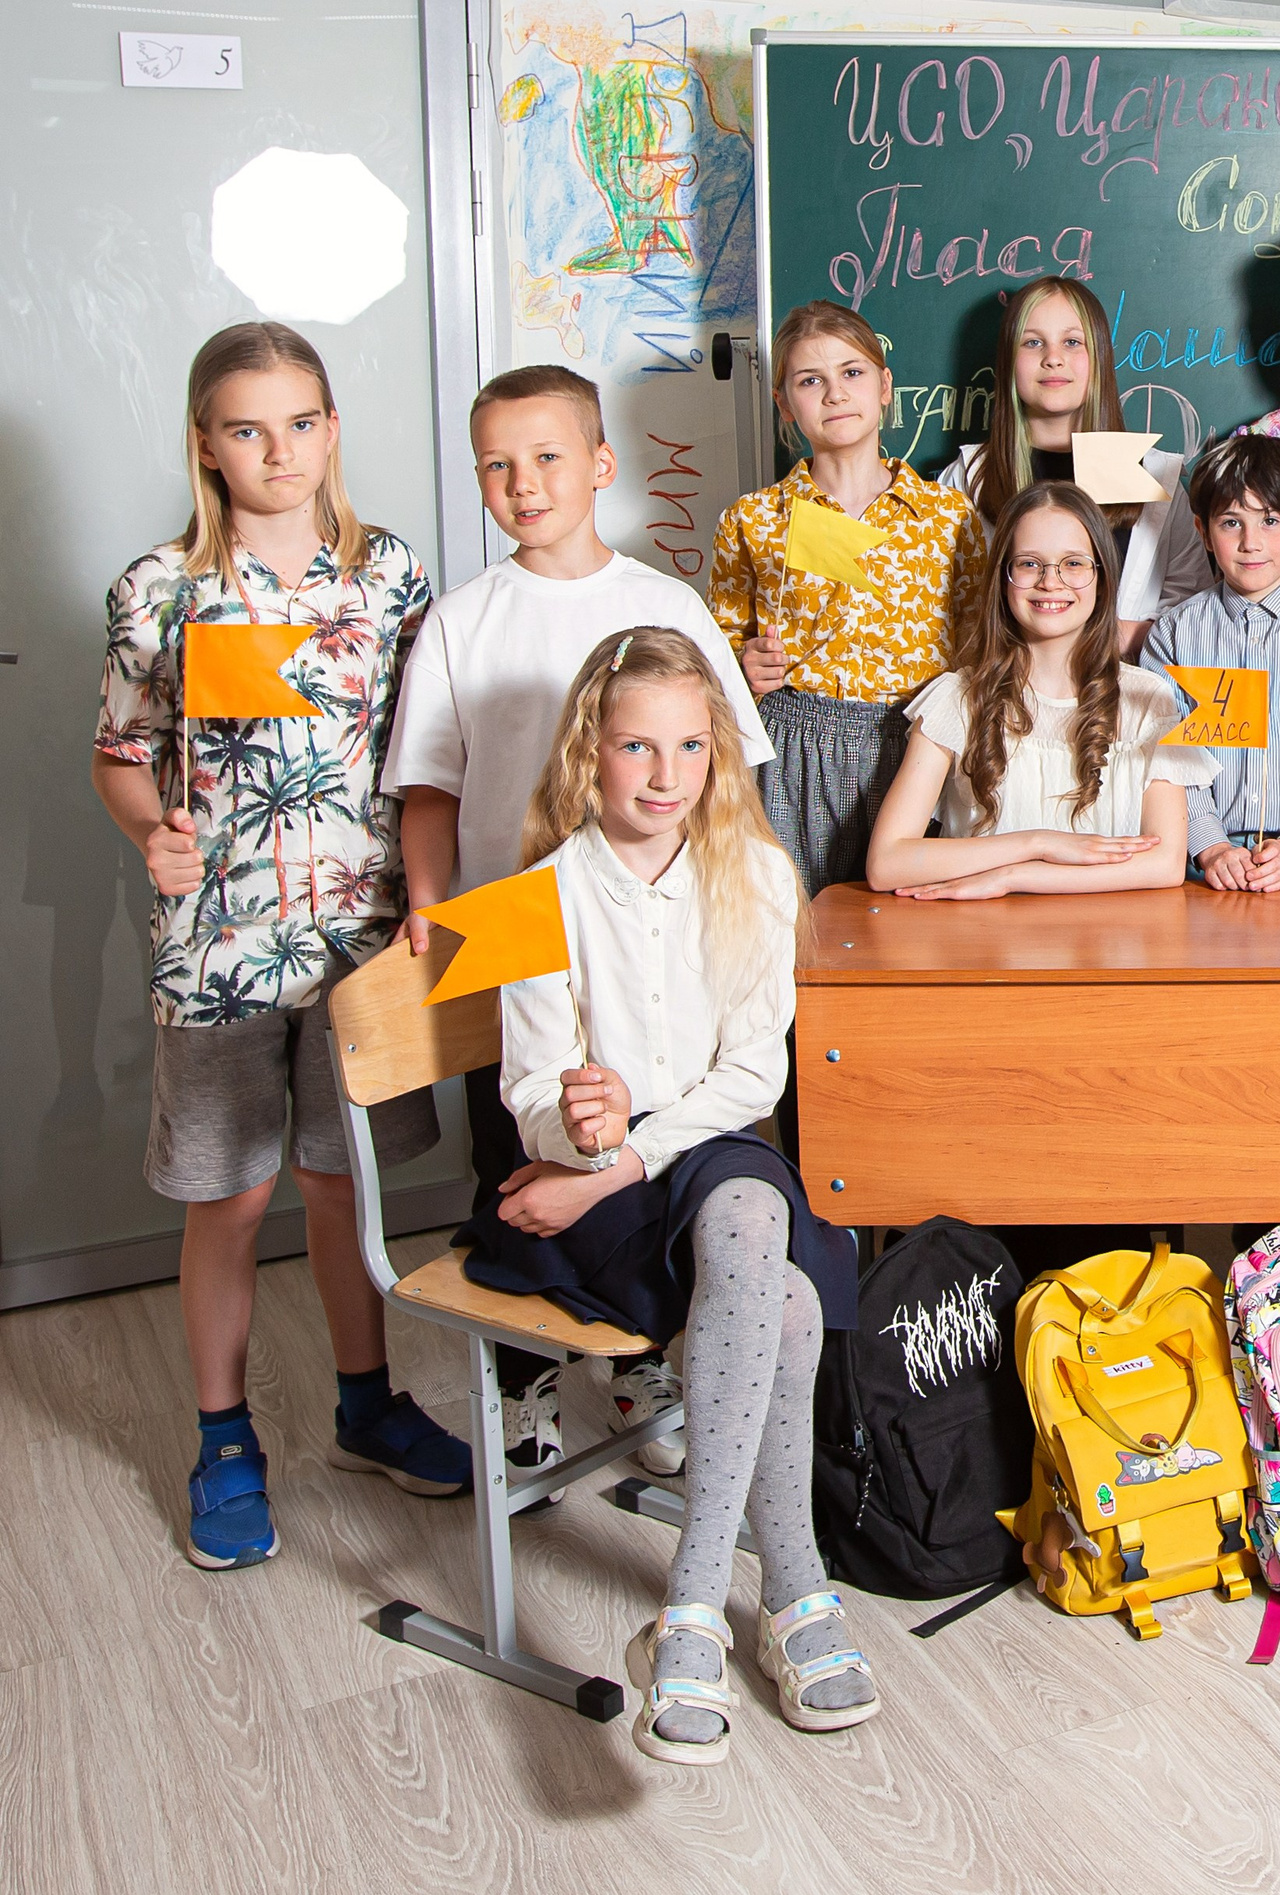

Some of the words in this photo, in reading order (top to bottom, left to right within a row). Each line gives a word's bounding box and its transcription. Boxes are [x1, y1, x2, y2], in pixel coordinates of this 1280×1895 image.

[215, 48, 232, 75] 5
[1213, 669, 1233, 717] 4
[1182, 721, 1250, 743] КЛАСС
[1112, 1361, 1143, 1373] kitty
